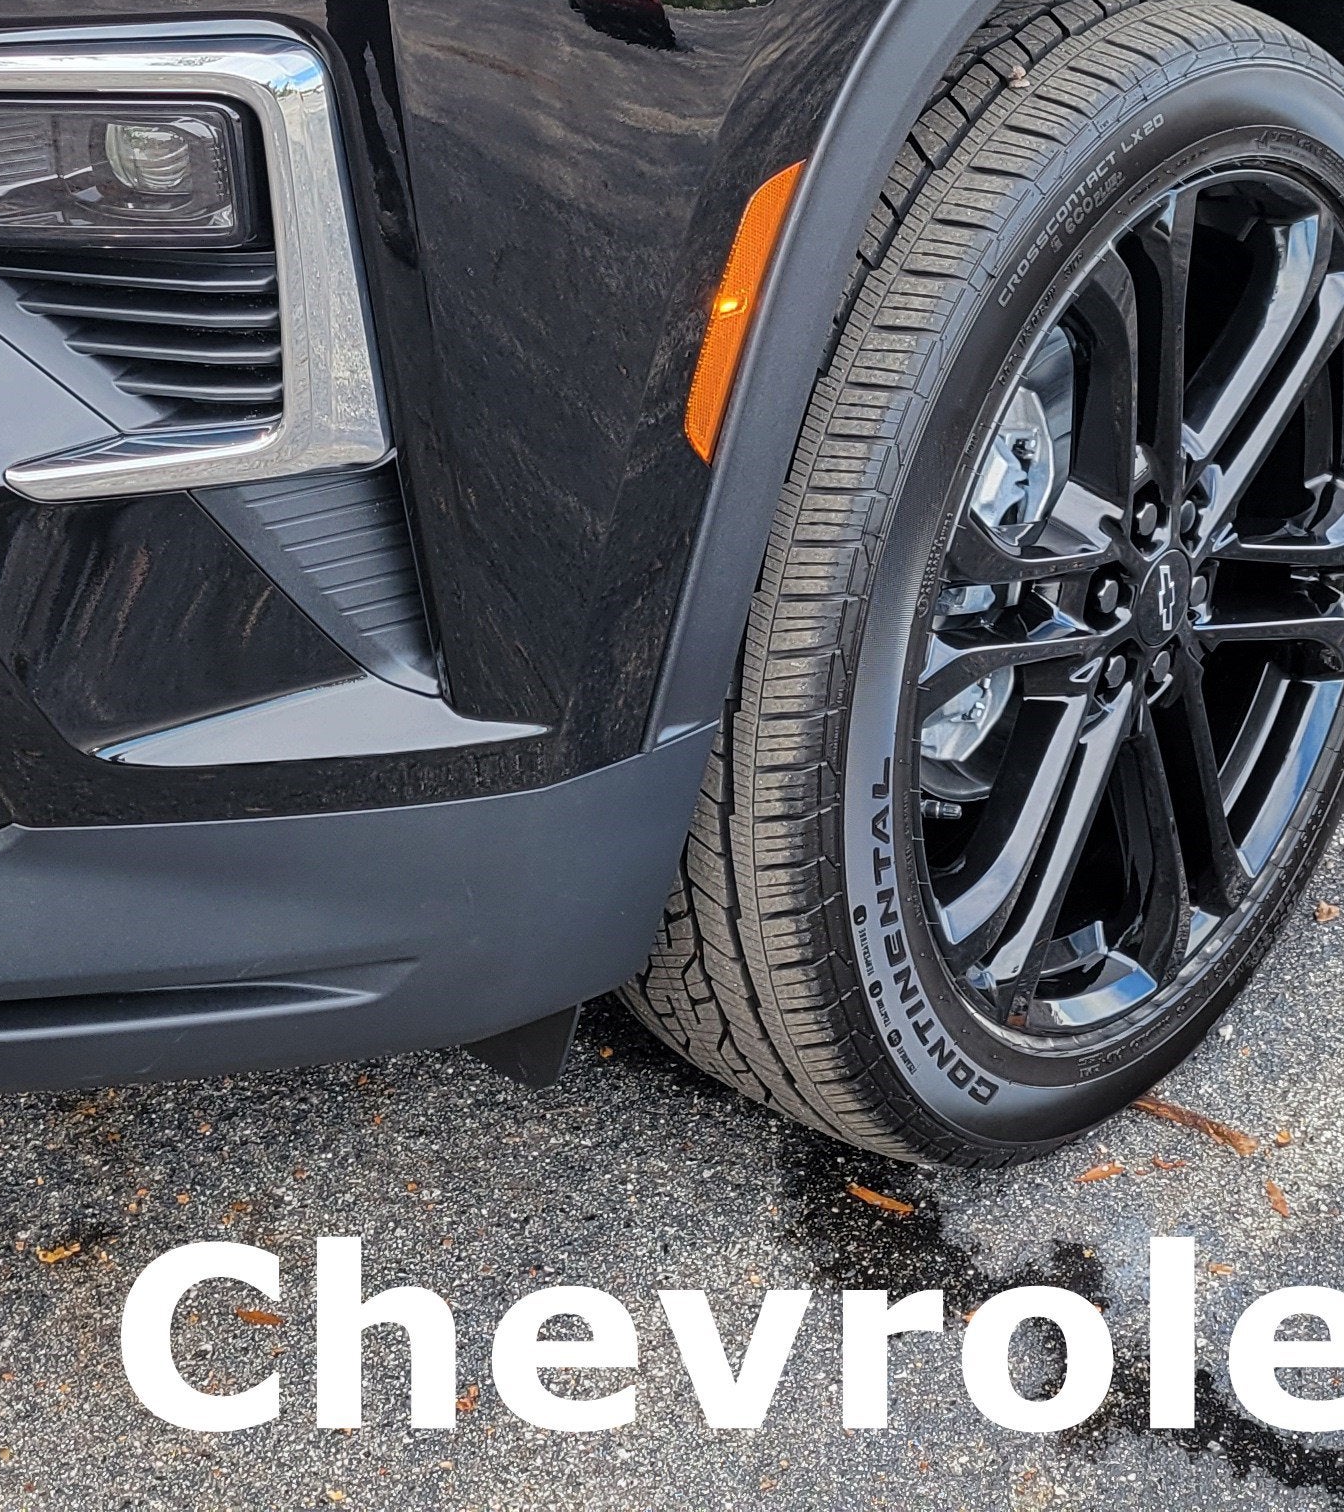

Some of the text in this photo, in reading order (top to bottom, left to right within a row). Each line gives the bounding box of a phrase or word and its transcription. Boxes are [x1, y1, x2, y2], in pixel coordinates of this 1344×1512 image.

[997, 150, 1117, 308] CROSSCONTACT
[1120, 112, 1166, 154] LX20
[871, 756, 1000, 1105] CONTINENTAL
